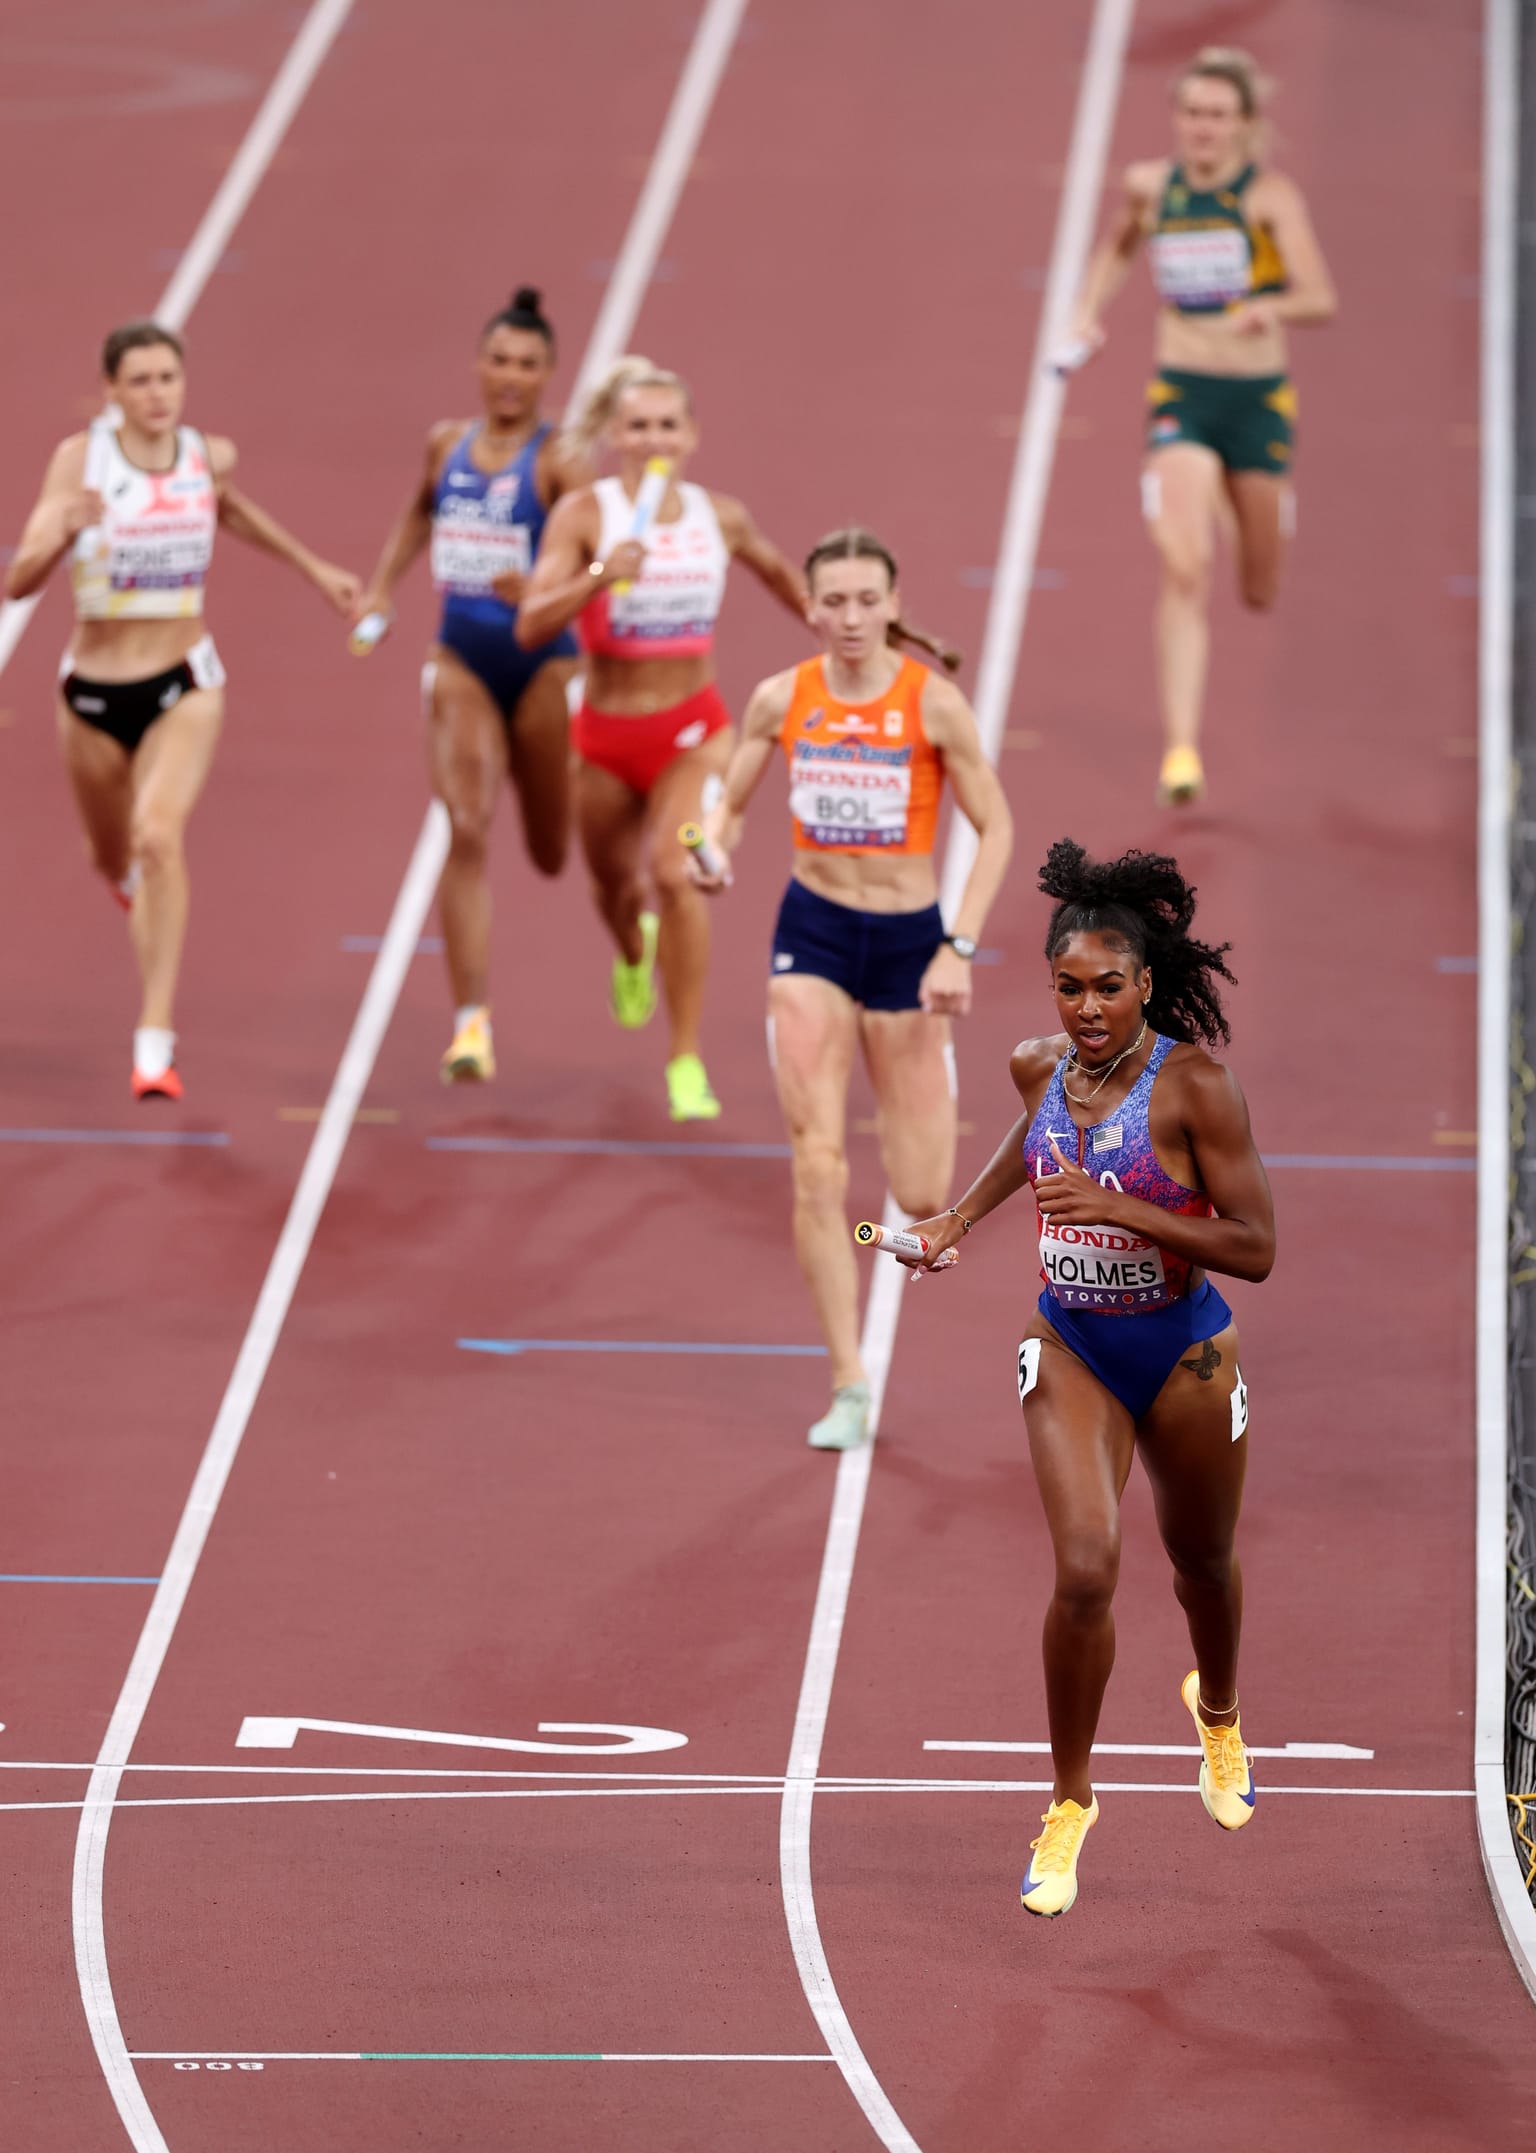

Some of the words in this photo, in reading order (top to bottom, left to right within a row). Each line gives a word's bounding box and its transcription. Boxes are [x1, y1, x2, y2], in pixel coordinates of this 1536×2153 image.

[796, 768, 902, 792] HONDA
[815, 795, 877, 824] BOL
[860, 1227, 872, 1239] 25
[1043, 1222, 1155, 1252] HONDA
[1043, 1251, 1157, 1287] HOLMES
[1018, 1349, 1028, 1392] 5
[234, 1715, 689, 1756] 2
[173, 2061, 265, 2071] 800
